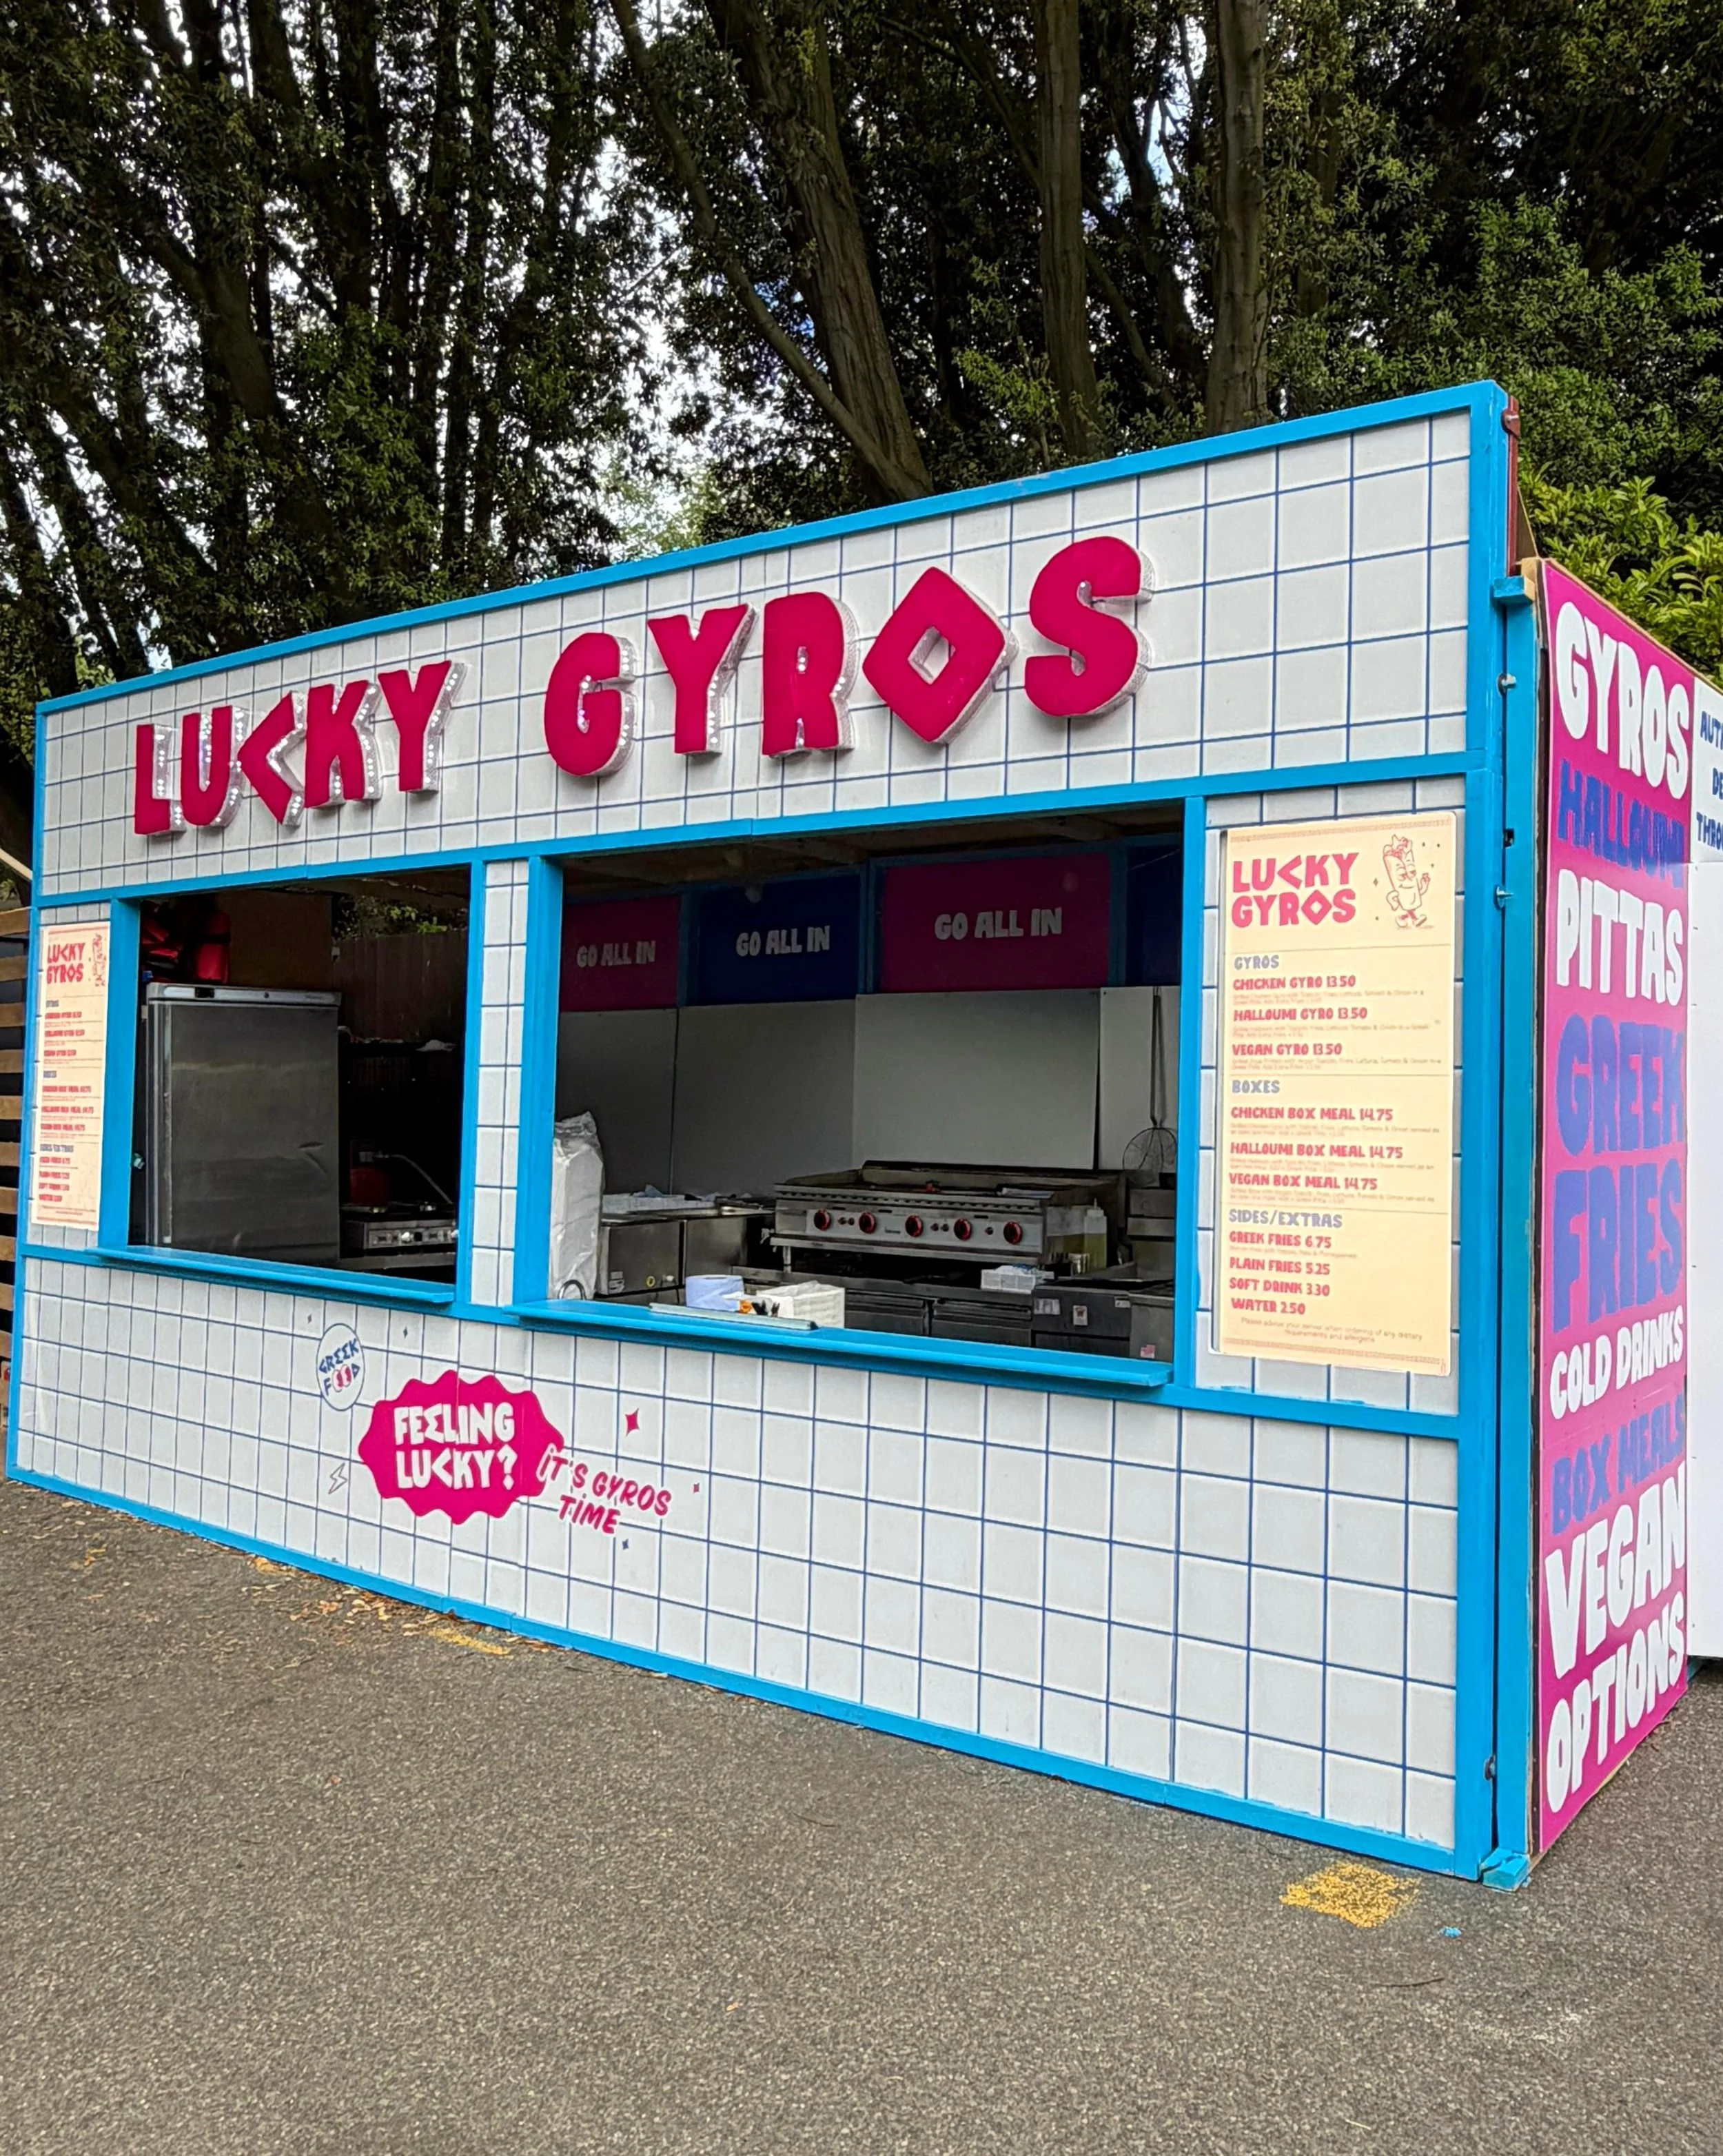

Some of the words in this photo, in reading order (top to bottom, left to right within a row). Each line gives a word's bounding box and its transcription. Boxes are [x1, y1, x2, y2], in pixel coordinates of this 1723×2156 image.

[134, 660, 466, 836] LUCKY
[544, 536, 1154, 777] GYROS
[1556, 601, 1689, 800] GYROS
[1696, 811, 1723, 851] THRO
[1233, 852, 1359, 893] LUCKY
[935, 912, 968, 940] GO
[974, 909, 1024, 938] ALL
[1030, 906, 1062, 937] IN
[1232, 889, 1356, 928] GYROS
[47, 942, 86, 964] LUCKY
[735, 930, 761, 957] GO
[765, 928, 802, 955] ALL
[806, 925, 830, 952] IN
[1557, 868, 1683, 1006] PITTAS
[577, 944, 598, 968] GO
[601, 942, 632, 966] ALL
[635, 940, 656, 964] IN
[1234, 955, 1280, 970] GYROS
[46, 963, 84, 984] GYROS
[1232, 977, 1286, 990] CHICKEN
[1289, 976, 1323, 988] GYRO
[1234, 1008, 1296, 1021] HALLOUMI
[1300, 1008, 1334, 1020] GYRO
[1232, 1044, 1273, 1056] VEGAN
[1276, 1043, 1309, 1055] GYRO
[1232, 1079, 1280, 1094] BOXES
[1555, 1014, 1684, 1156] GREEK
[1230, 1106, 1285, 1119] CHICKEN
[1287, 1107, 1316, 1119] BOX
[1320, 1108, 1356, 1120] MEAL
[1230, 1142, 1293, 1156] HALLOUMI
[1296, 1143, 1325, 1157] BOX
[1329, 1144, 1366, 1158] MEAL
[1229, 1172, 1270, 1186] VEGAN
[1273, 1174, 1301, 1187] BOX
[1305, 1175, 1340, 1189] MEAL
[1229, 1208, 1343, 1228] SIDES/EXTRAS
[1229, 1230, 1264, 1244] GREEK
[1268, 1233, 1301, 1247] FRIES
[1552, 1158, 1682, 1334] FRIES
[1230, 1257, 1265, 1271] PLAIN
[1268, 1259, 1302, 1273] FRIES
[1229, 1277, 1260, 1291] SOFT
[1263, 1280, 1303, 1294] DRINK
[1231, 1297, 1277, 1312] WATER
[1550, 1334, 1613, 1420] COLD
[1616, 1305, 1683, 1390] DRINKS
[394, 1402, 516, 1446] FEELING
[396, 1444, 518, 1491] LUCKY?
[1552, 1434, 1611, 1536] BOX
[1617, 1392, 1685, 1494] MEALS
[593, 1471, 672, 1516] GYROS
[1544, 1460, 1685, 1679] VEGAN
[1547, 1591, 1684, 1813] OPTIONS
